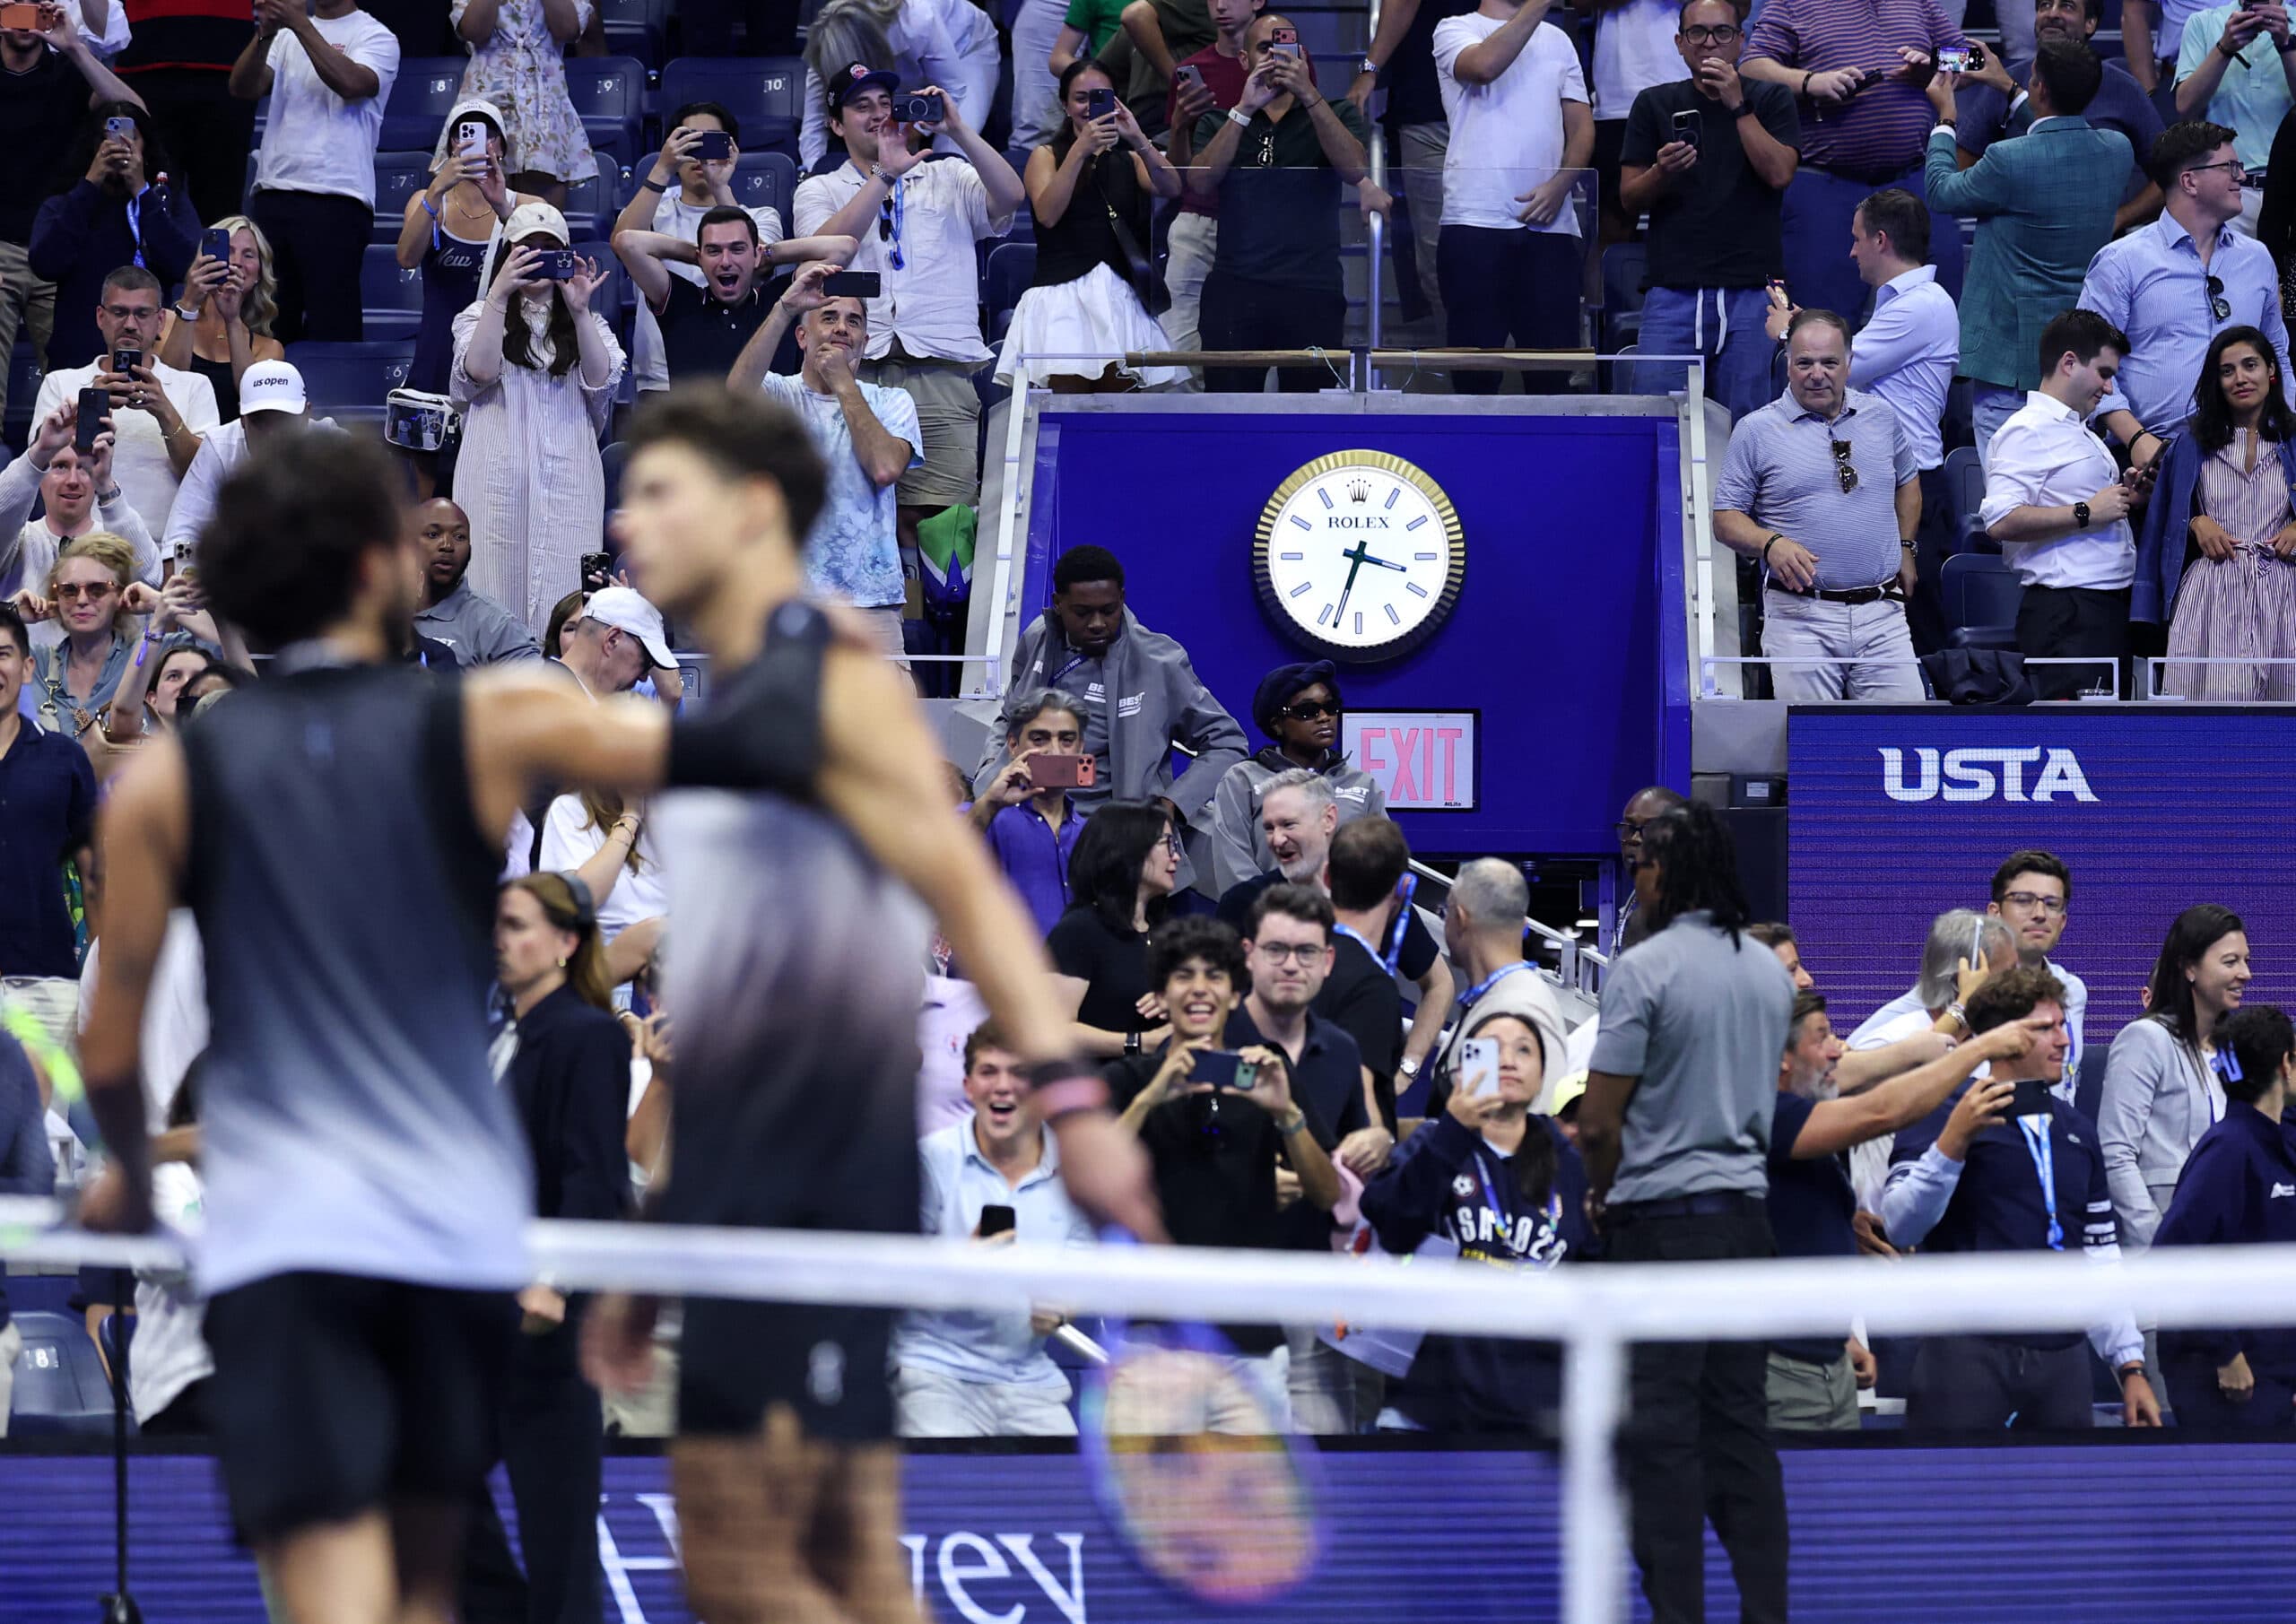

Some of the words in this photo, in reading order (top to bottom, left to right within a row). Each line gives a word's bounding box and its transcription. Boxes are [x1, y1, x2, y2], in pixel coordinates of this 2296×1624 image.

[437, 80, 446, 91] 8
[604, 79, 613, 91] 9
[768, 78, 783, 91] 10
[399, 176, 407, 187] 7
[753, 177, 762, 188] 9
[407, 269, 416, 280] 7
[393, 366, 402, 378] 6
[253, 378, 264, 387] us
[264, 378, 288, 386] open
[1327, 517, 1389, 529] ROLEX
[1118, 691, 1145, 708] BEST
[1360, 727, 1463, 801] EXIT
[1877, 745, 2101, 802] USTA
[36, 1348, 49, 1368] 8
